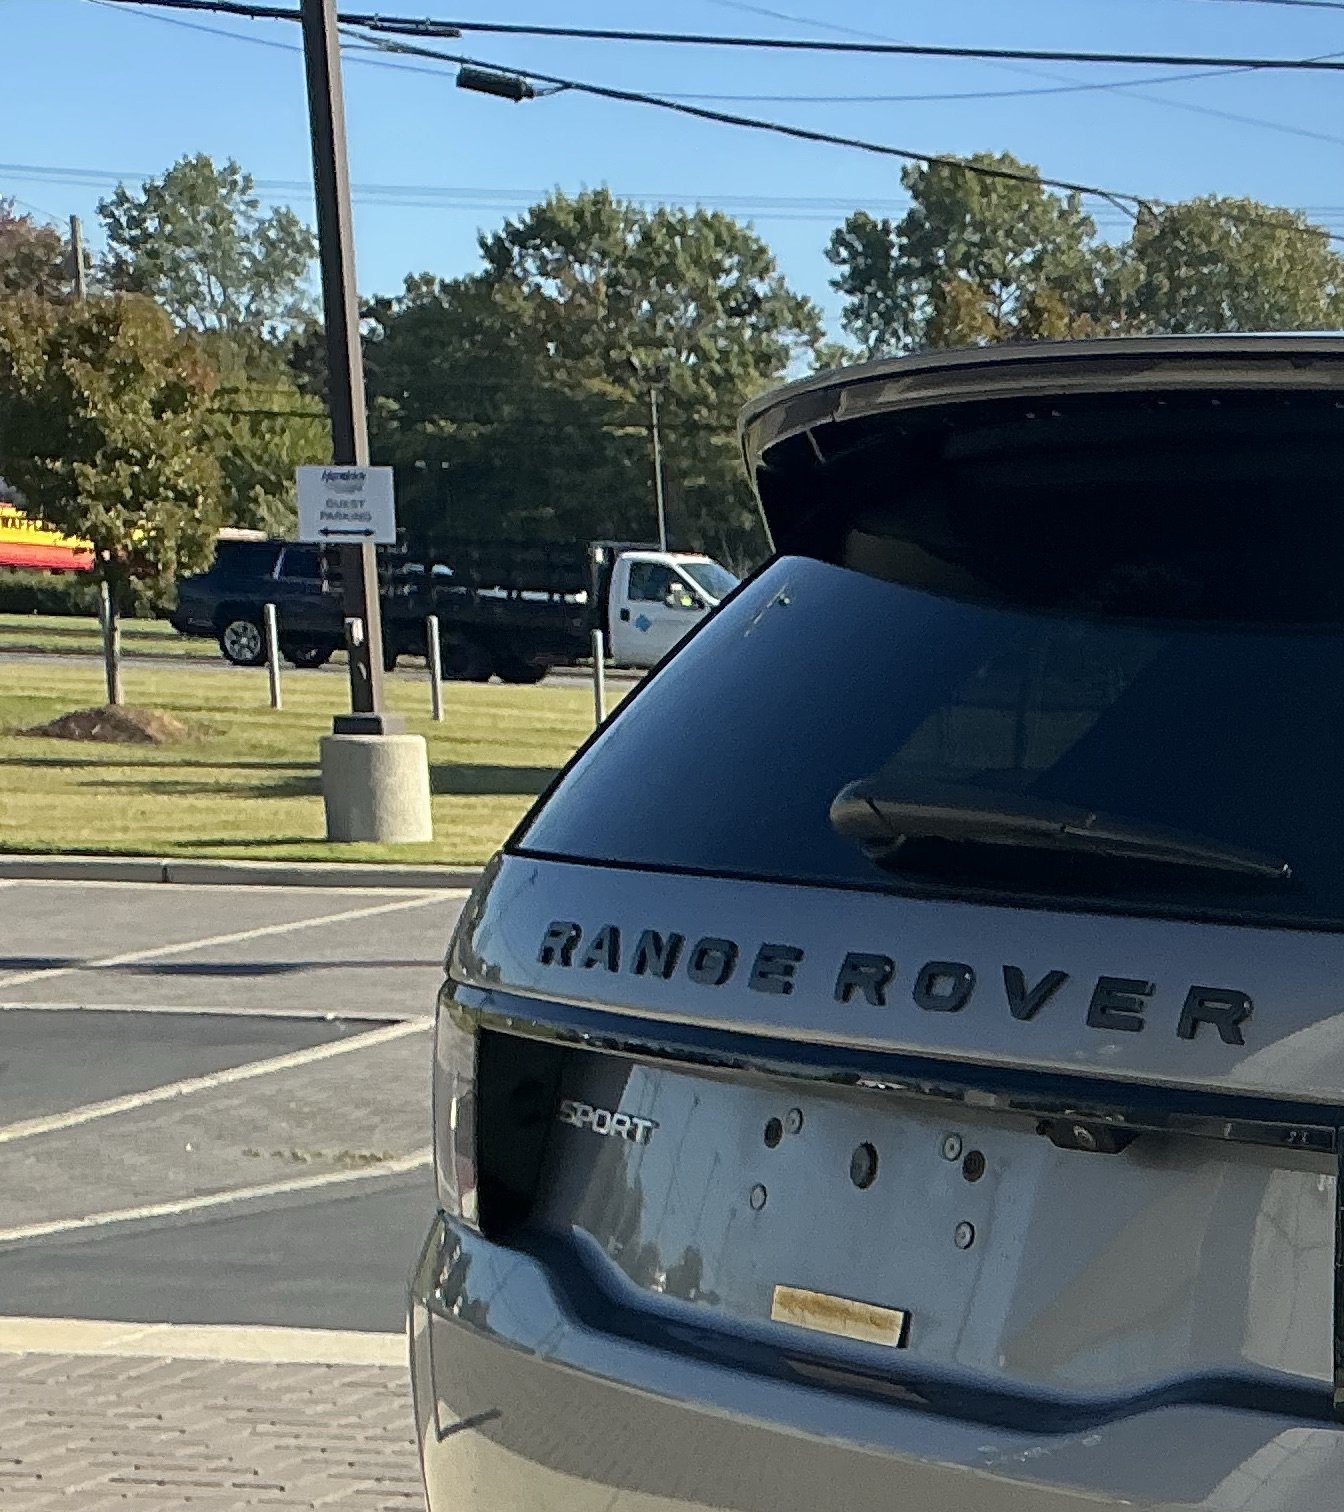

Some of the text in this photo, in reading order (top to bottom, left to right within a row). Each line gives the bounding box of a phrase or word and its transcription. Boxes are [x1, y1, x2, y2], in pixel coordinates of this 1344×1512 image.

[537, 921, 1255, 1046] RANGE ROVER
[560, 1100, 653, 1143] SPORT
